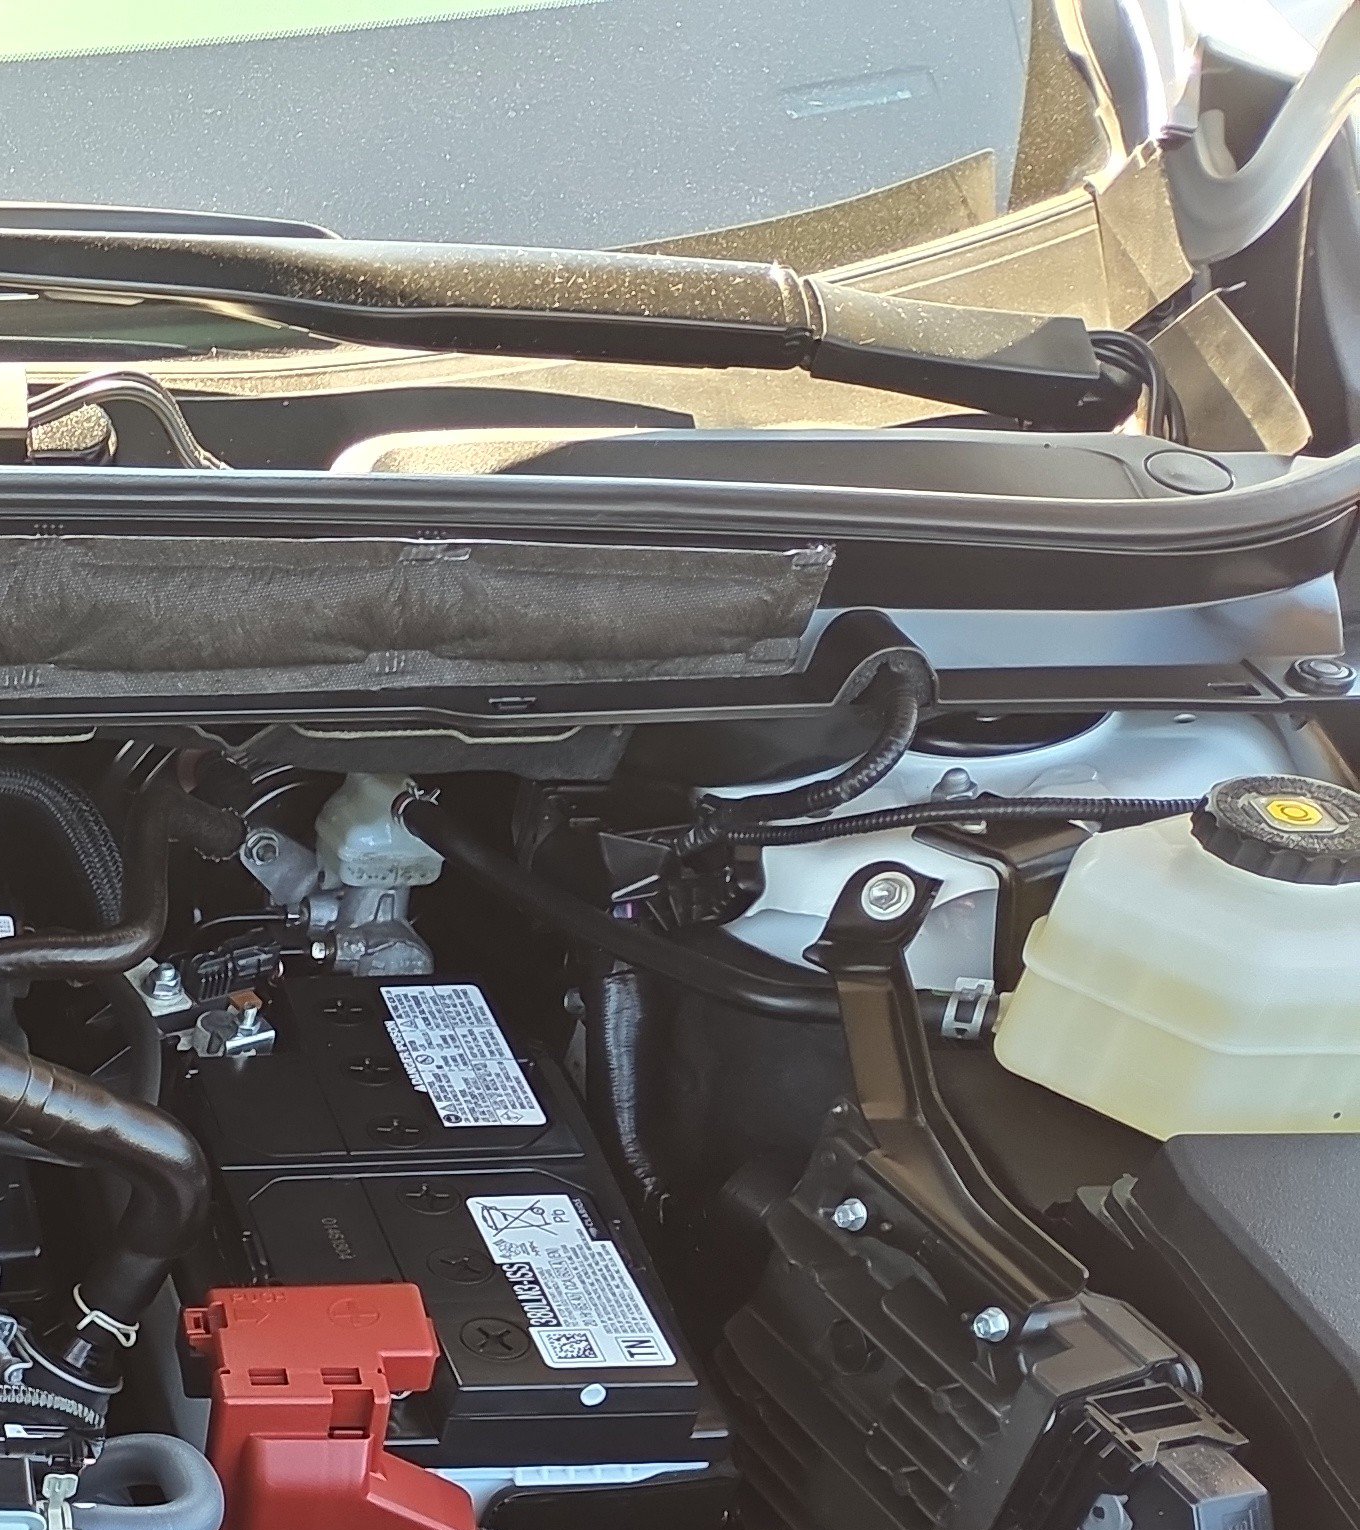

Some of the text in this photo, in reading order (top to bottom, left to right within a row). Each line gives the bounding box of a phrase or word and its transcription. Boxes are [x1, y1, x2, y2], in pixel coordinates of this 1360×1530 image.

[552, 1209, 569, 1223] Pb
[501, 1263, 558, 1326] 380LN3-ISS
[621, 1339, 658, 1358] TN
